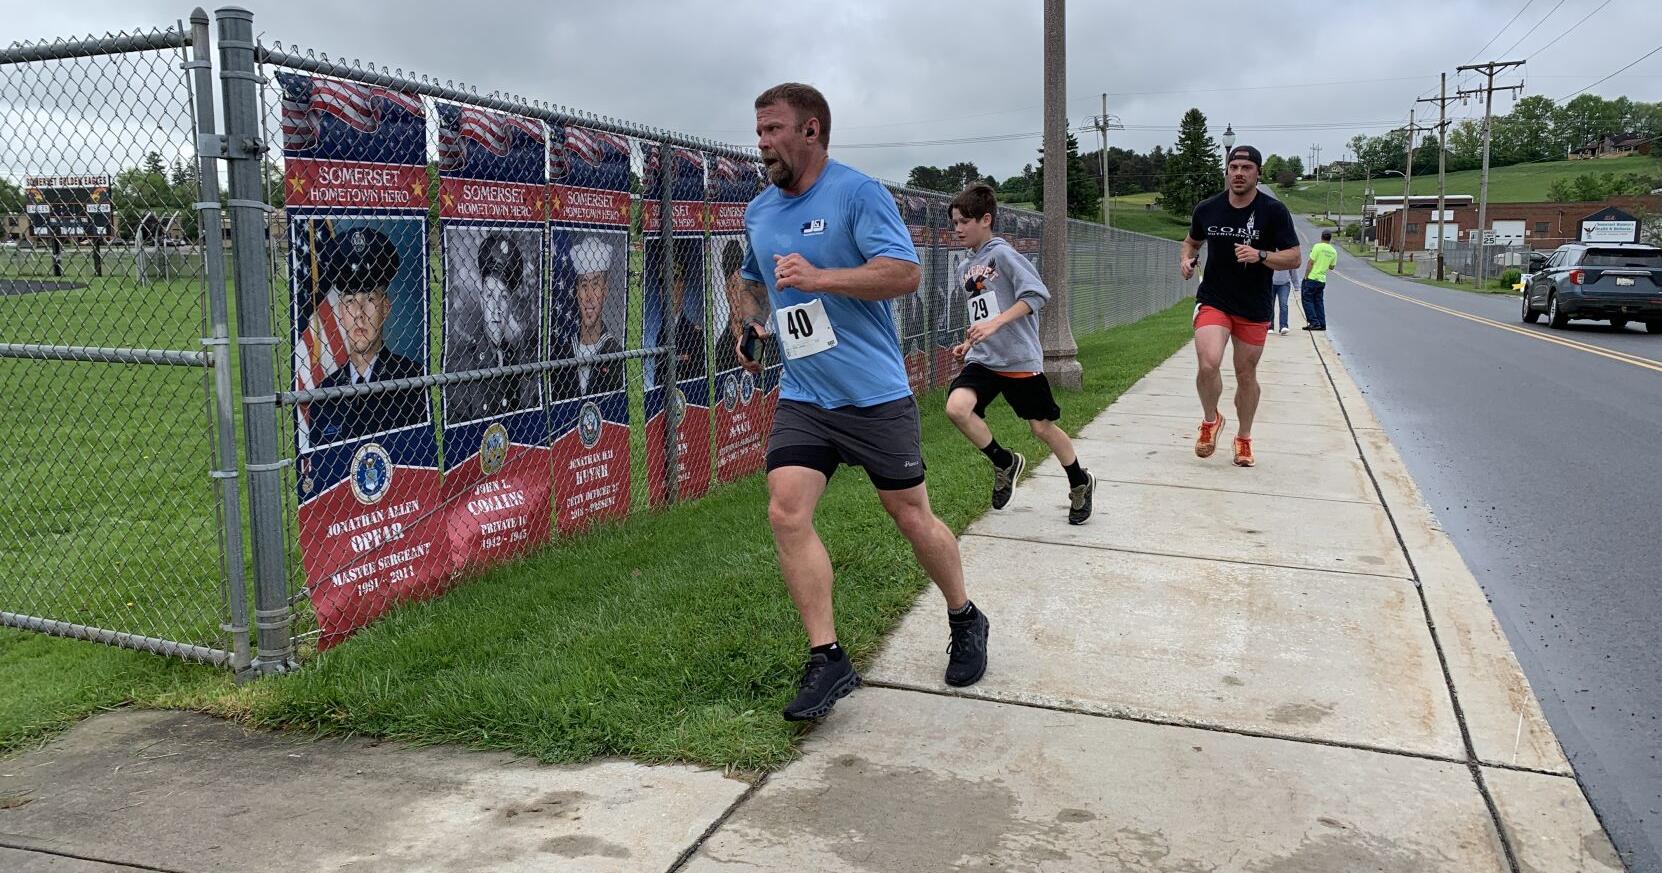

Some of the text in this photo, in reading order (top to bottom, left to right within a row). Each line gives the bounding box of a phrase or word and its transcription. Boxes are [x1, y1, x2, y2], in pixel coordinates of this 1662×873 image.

[319, 166, 401, 187] SOMERSET
[310, 187, 409, 203] HOMETOWN HERO
[463, 184, 526, 203] SOMERSET
[567, 190, 614, 208] SOMERSET
[457, 202, 533, 217] HOMETOWN HERO
[719, 206, 745, 217] SOMERSE
[1207, 225, 1260, 236] CORE
[972, 298, 989, 321] 29
[787, 308, 814, 340] 40
[576, 463, 609, 486] HUYNH
[474, 479, 511, 496] JOHN L.
[467, 489, 526, 516] COLLINS
[326, 500, 420, 538] JONATHAN ALLEN
[480, 517, 516, 536] PRIVATE
[331, 542, 432, 588] MASTER SERGEANT
